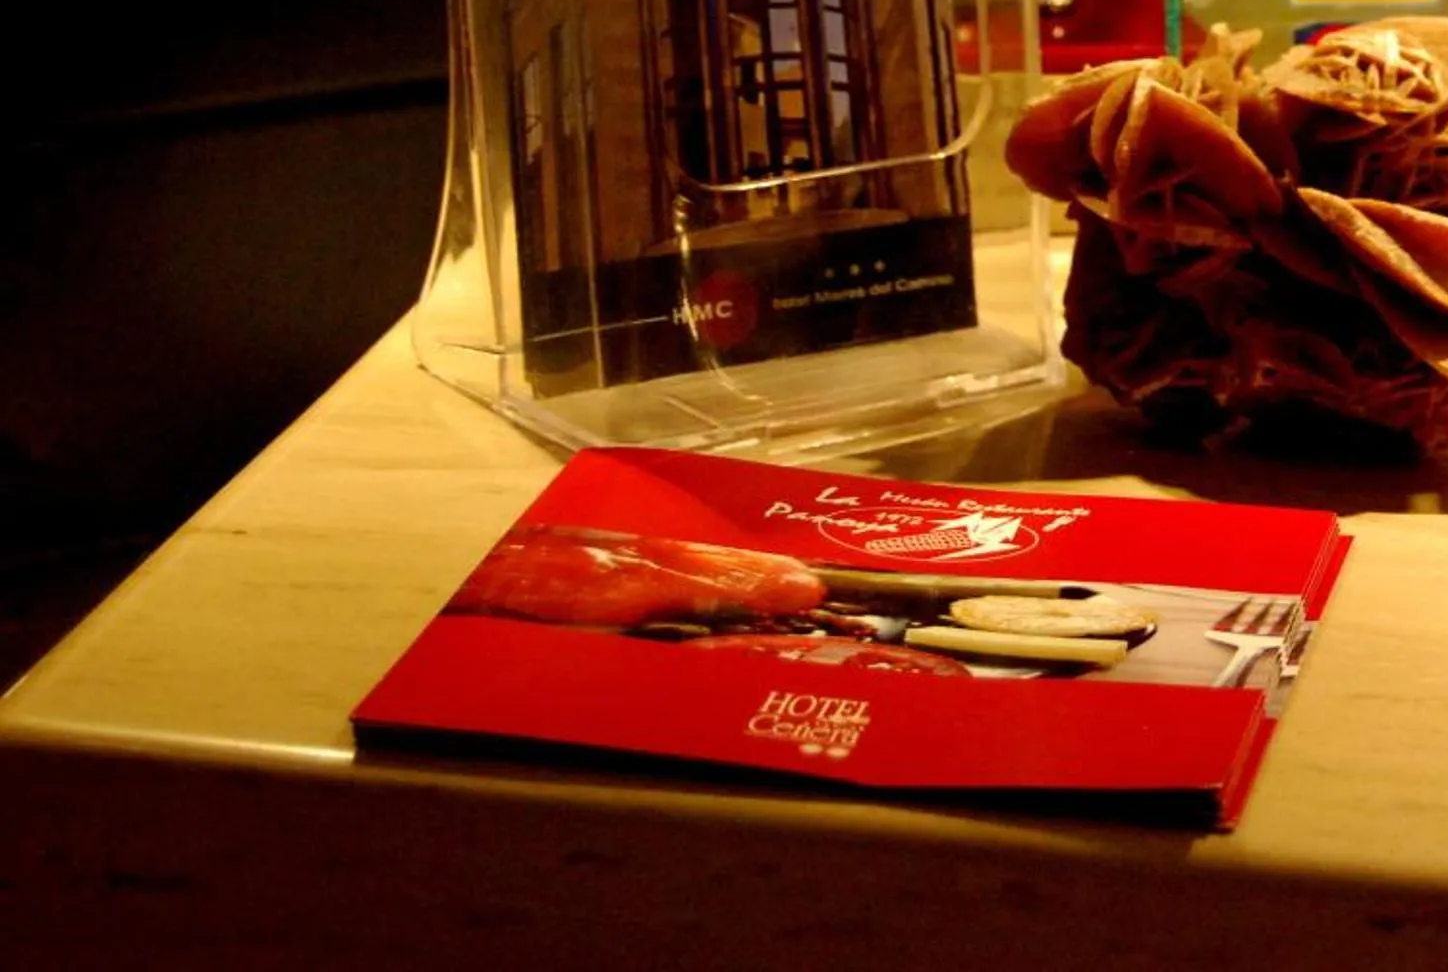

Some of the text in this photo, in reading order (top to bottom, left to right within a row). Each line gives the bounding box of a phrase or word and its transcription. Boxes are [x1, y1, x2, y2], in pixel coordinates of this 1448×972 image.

[671, 300, 734, 326] HMC
[815, 486, 861, 506] La
[759, 690, 870, 722] HOTEL
